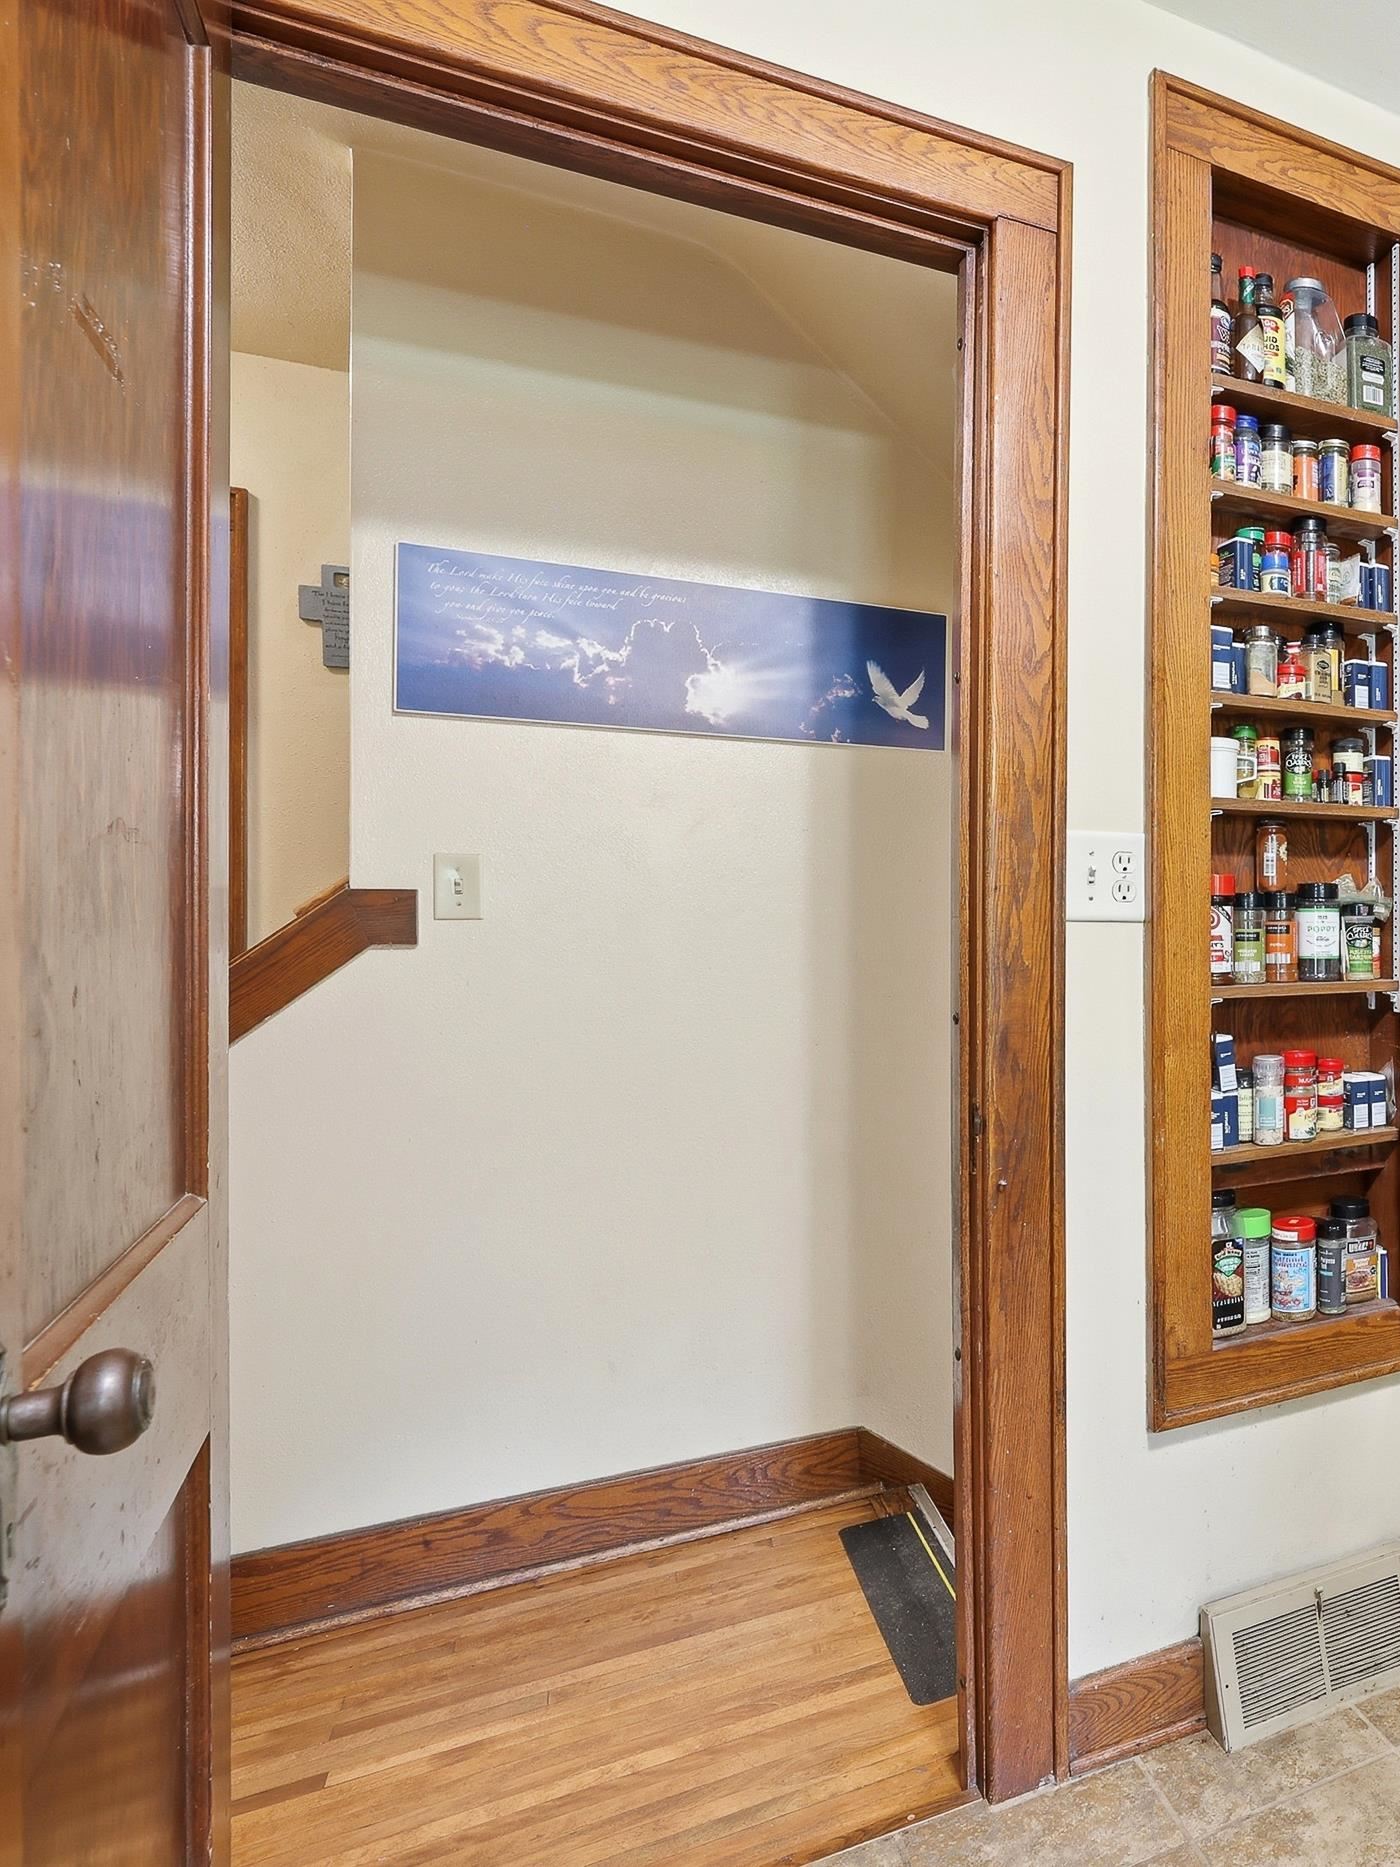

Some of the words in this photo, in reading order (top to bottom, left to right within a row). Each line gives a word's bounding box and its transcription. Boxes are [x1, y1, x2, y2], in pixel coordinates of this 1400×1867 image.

[427, 559, 449, 574] The
[450, 566, 478, 578] Lord
[479, 567, 504, 581] make
[521, 571, 550, 593] face
[552, 575, 575, 590] shine
[577, 584, 599, 599] upon
[594, 588, 617, 600] you
[620, 584, 643, 598] and
[641, 592, 687, 608] gracious
[430, 581, 442, 590] to
[470, 580, 491, 595] the
[490, 585, 521, 600] Lord
[559, 590, 582, 610] face
[585, 597, 624, 610] toward
[434, 600, 464, 614] you
[465, 599, 490, 611] and
[501, 608, 526, 621] you
